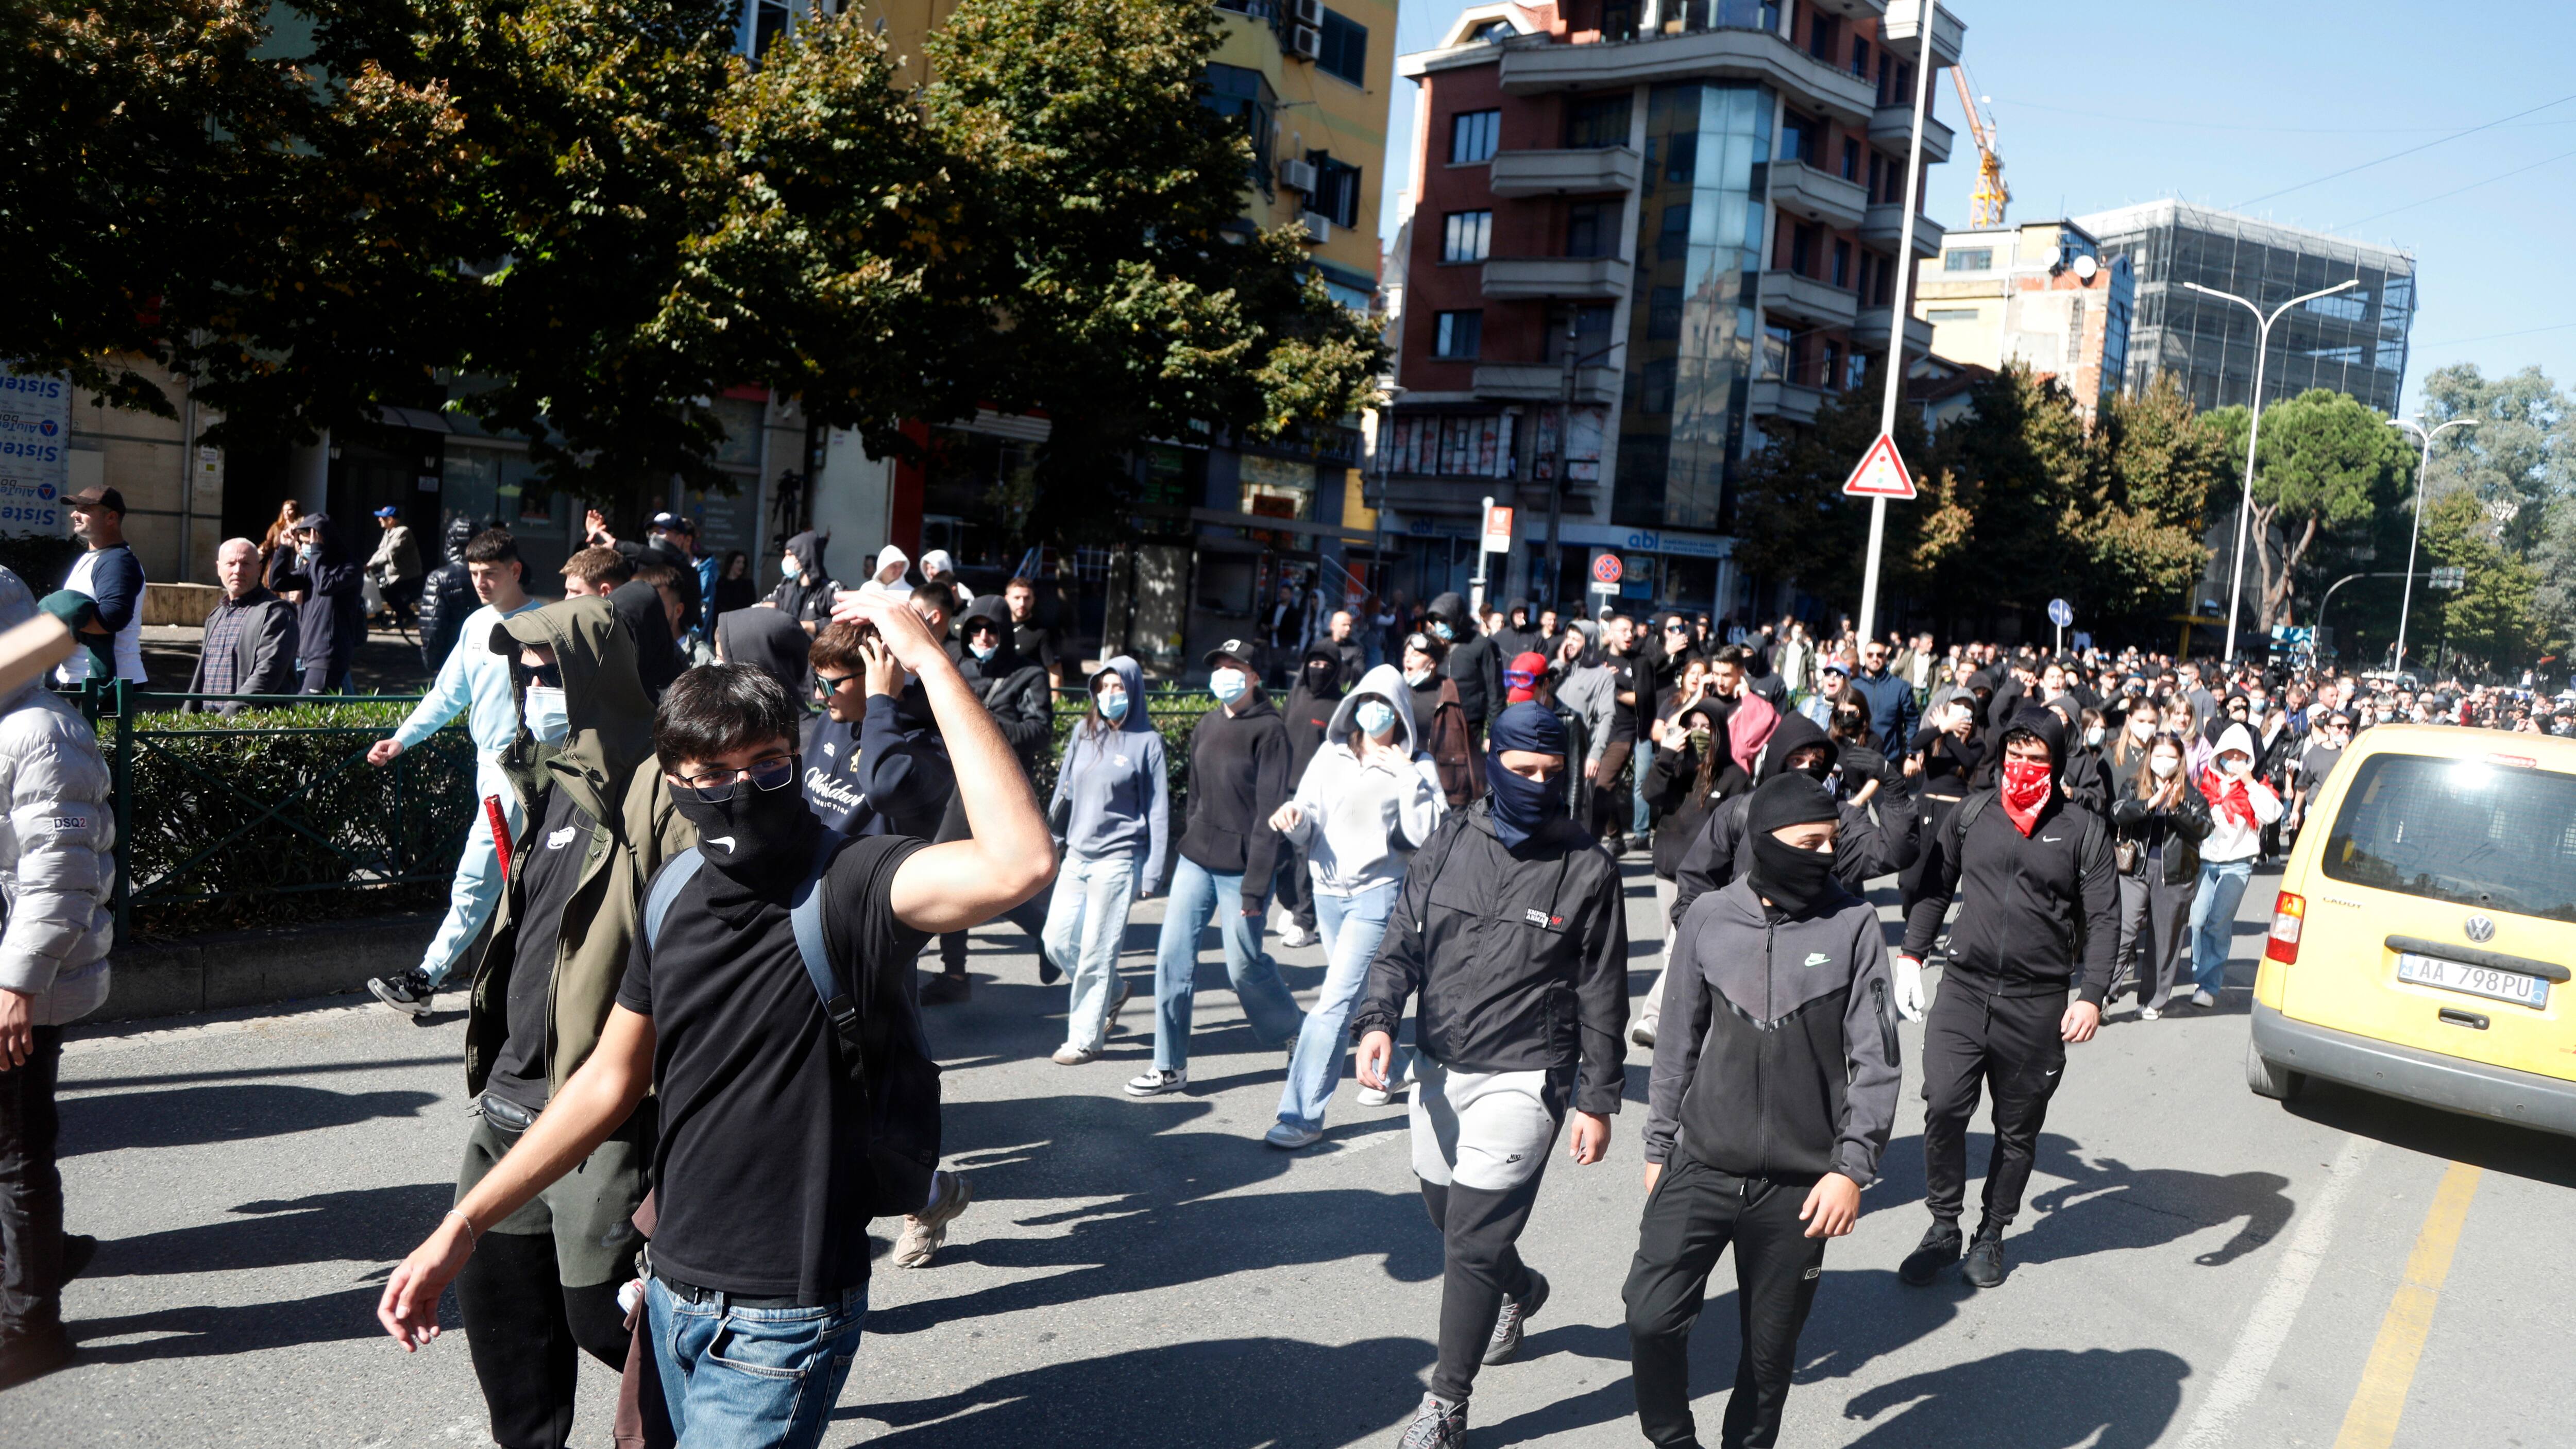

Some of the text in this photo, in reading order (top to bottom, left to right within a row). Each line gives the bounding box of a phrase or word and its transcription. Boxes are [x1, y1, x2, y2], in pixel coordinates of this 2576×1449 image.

[0, 442, 58, 462] Siste
[54, 817, 86, 828] DSQ2
[1527, 908, 1547, 918] EMPOR
[1526, 914, 1545, 924] ARMA
[2419, 960, 2444, 981] AA
